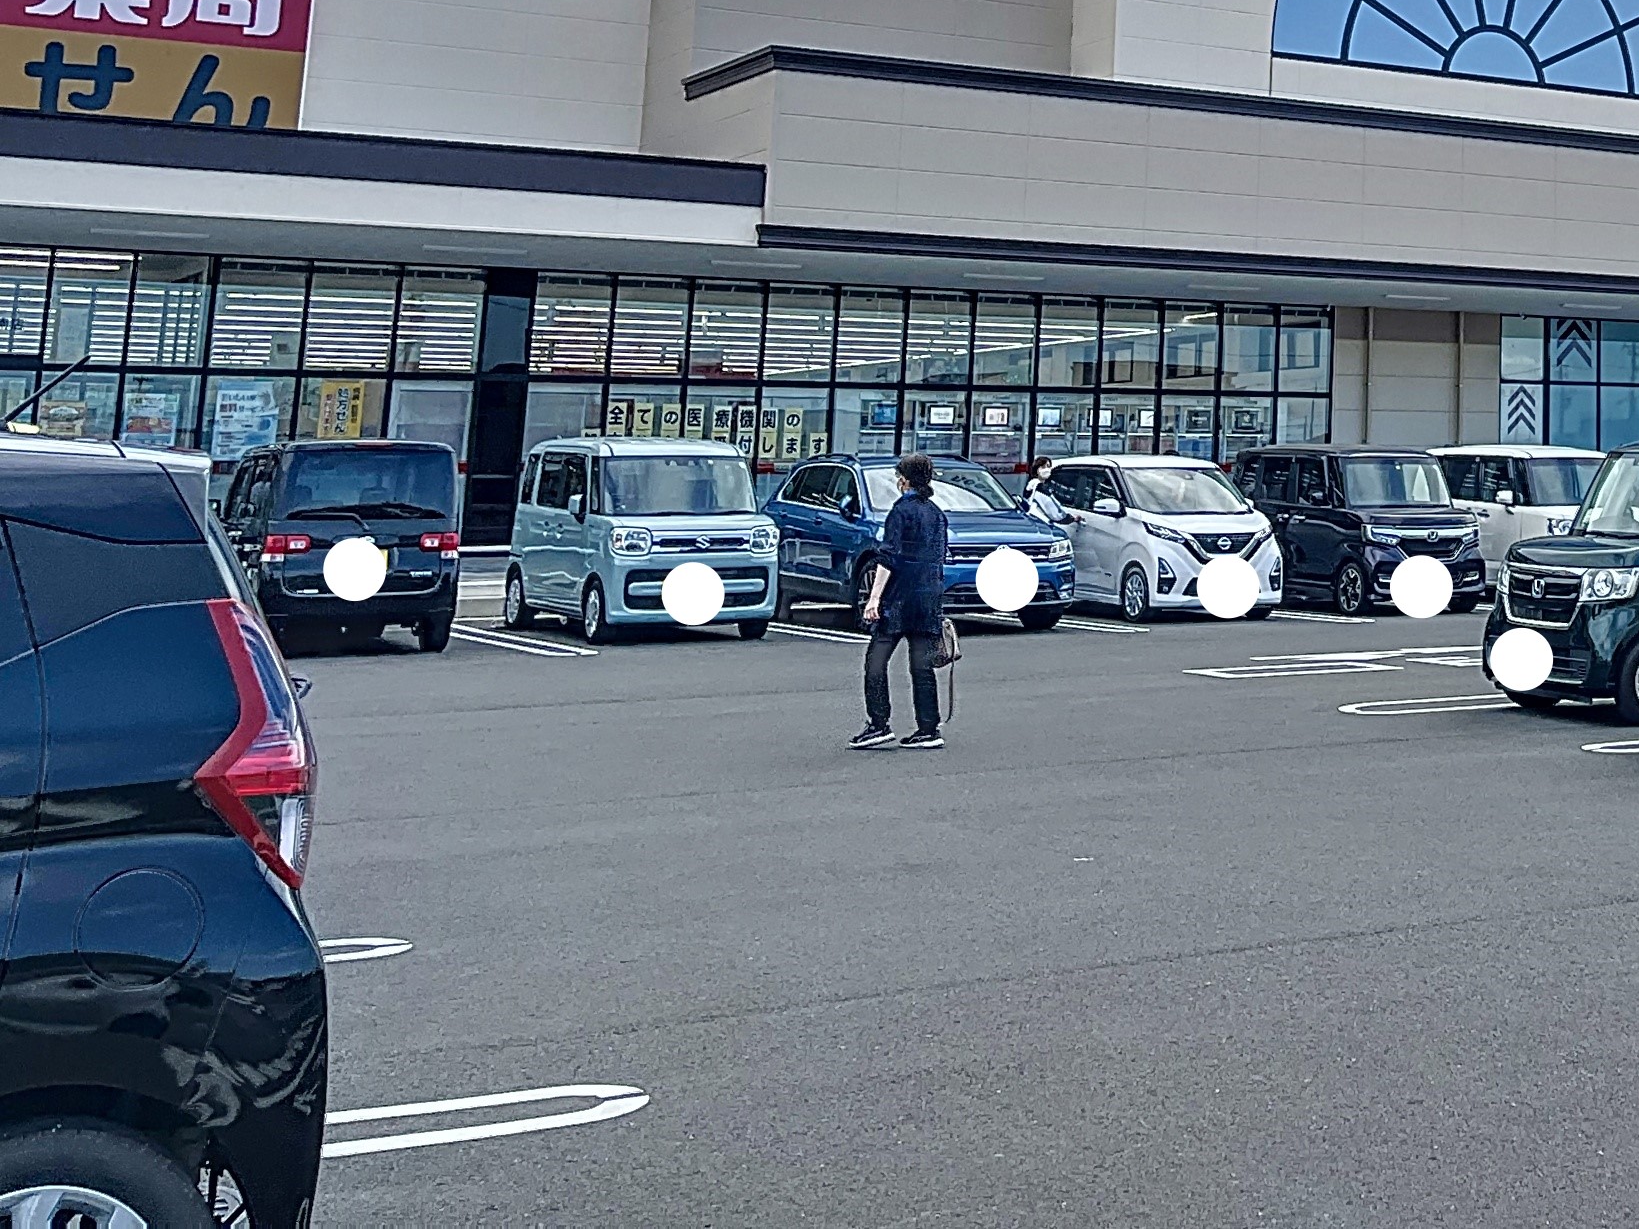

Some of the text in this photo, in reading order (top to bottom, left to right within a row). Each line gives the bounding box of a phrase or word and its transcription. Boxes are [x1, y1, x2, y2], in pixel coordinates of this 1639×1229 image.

[24, 41, 271, 131] せん
[608, 404, 802, 429] 全ての医療機関の
